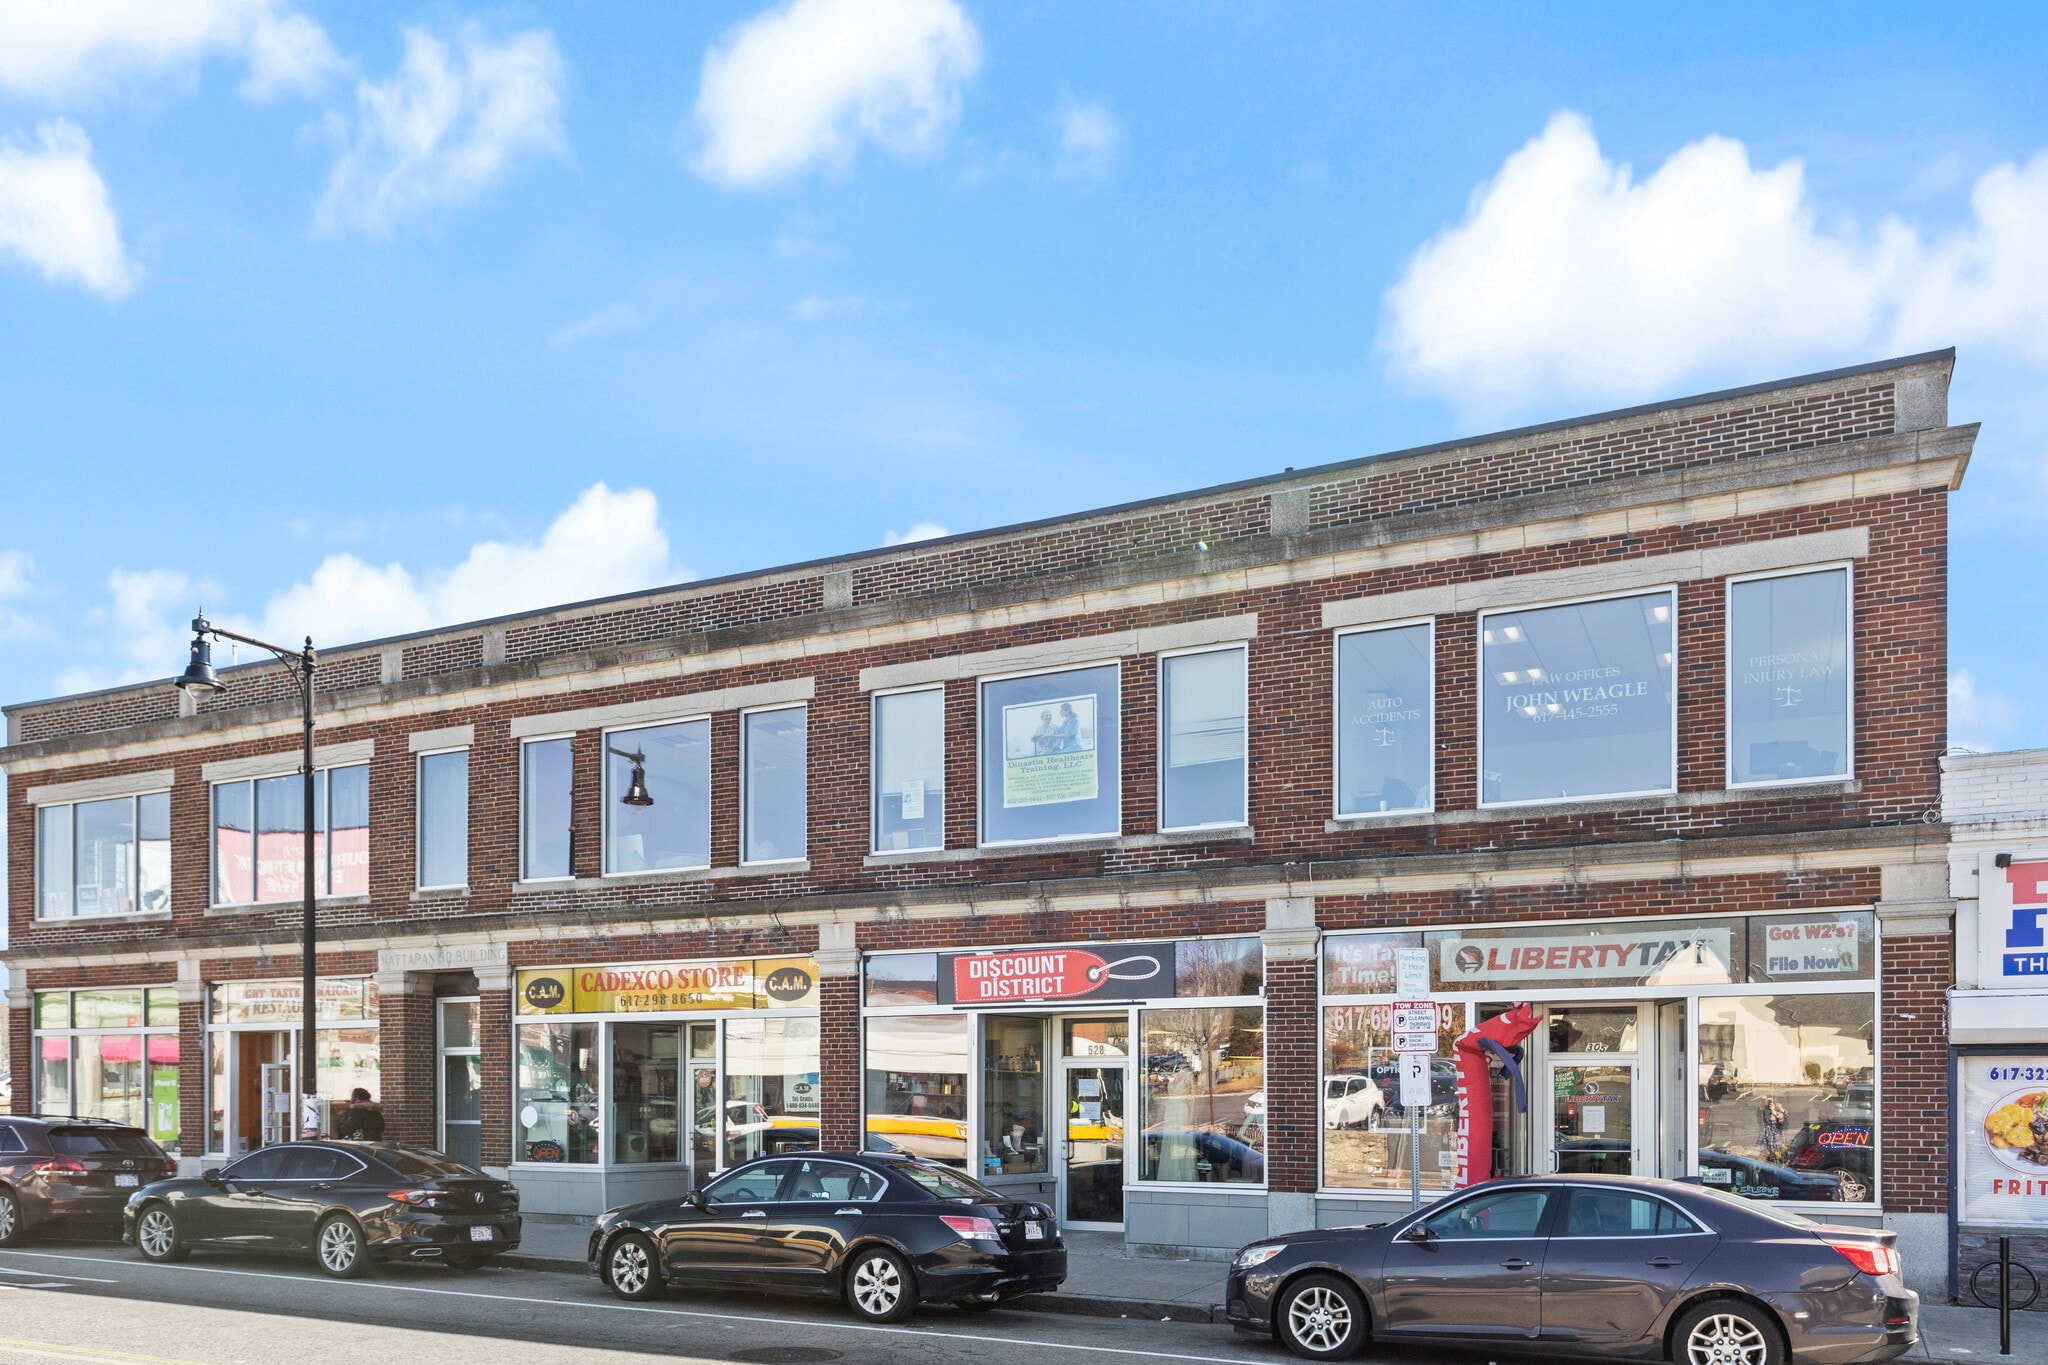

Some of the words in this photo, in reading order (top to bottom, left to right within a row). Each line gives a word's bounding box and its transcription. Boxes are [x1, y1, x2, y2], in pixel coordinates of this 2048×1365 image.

[1750, 650, 1826, 667] PERSONAL
[1533, 673, 1562, 686] LAW
[1565, 666, 1621, 682] OFFICES
[1744, 669, 1796, 685] INJURY
[1800, 665, 1834, 678] LAW
[1368, 697, 1403, 710] AUTO
[1505, 691, 1558, 713] JOHN
[1563, 681, 1648, 703] WEAGLE
[1351, 709, 1421, 726] ACCIDENTS
[1533, 704, 1619, 724] 617-445-2555
[1008, 759, 1043, 768] Dinastia
[1047, 753, 1094, 764] Healthcare
[1063, 760, 1082, 769] LLC
[1769, 926, 1800, 941] Got
[1804, 923, 1856, 939] W2's?
[381, 952, 436, 967] MATTAPAN
[456, 948, 506, 963] BUILDING
[1335, 945, 1364, 962] It's
[1400, 954, 1426, 963] Parking
[1769, 956, 1799, 971] File
[1804, 955, 1840, 970] Now
[2013, 957, 2048, 973] TH
[581, 970, 674, 993] CADEXCO
[678, 966, 745, 990] STORE
[769, 975, 807, 992] C.A.M.
[1338, 966, 1396, 984] Time!
[269, 987, 300, 999] TASTE
[529, 985, 561, 999] C.A.M.
[980, 976, 1065, 997] DISTRICT
[620, 992, 703, 1007] 617-298-8650
[1087, 1045, 1105, 1056] 528
[1818, 1131, 1870, 1146] OPEN
[532, 1146, 561, 1159] OPEN
